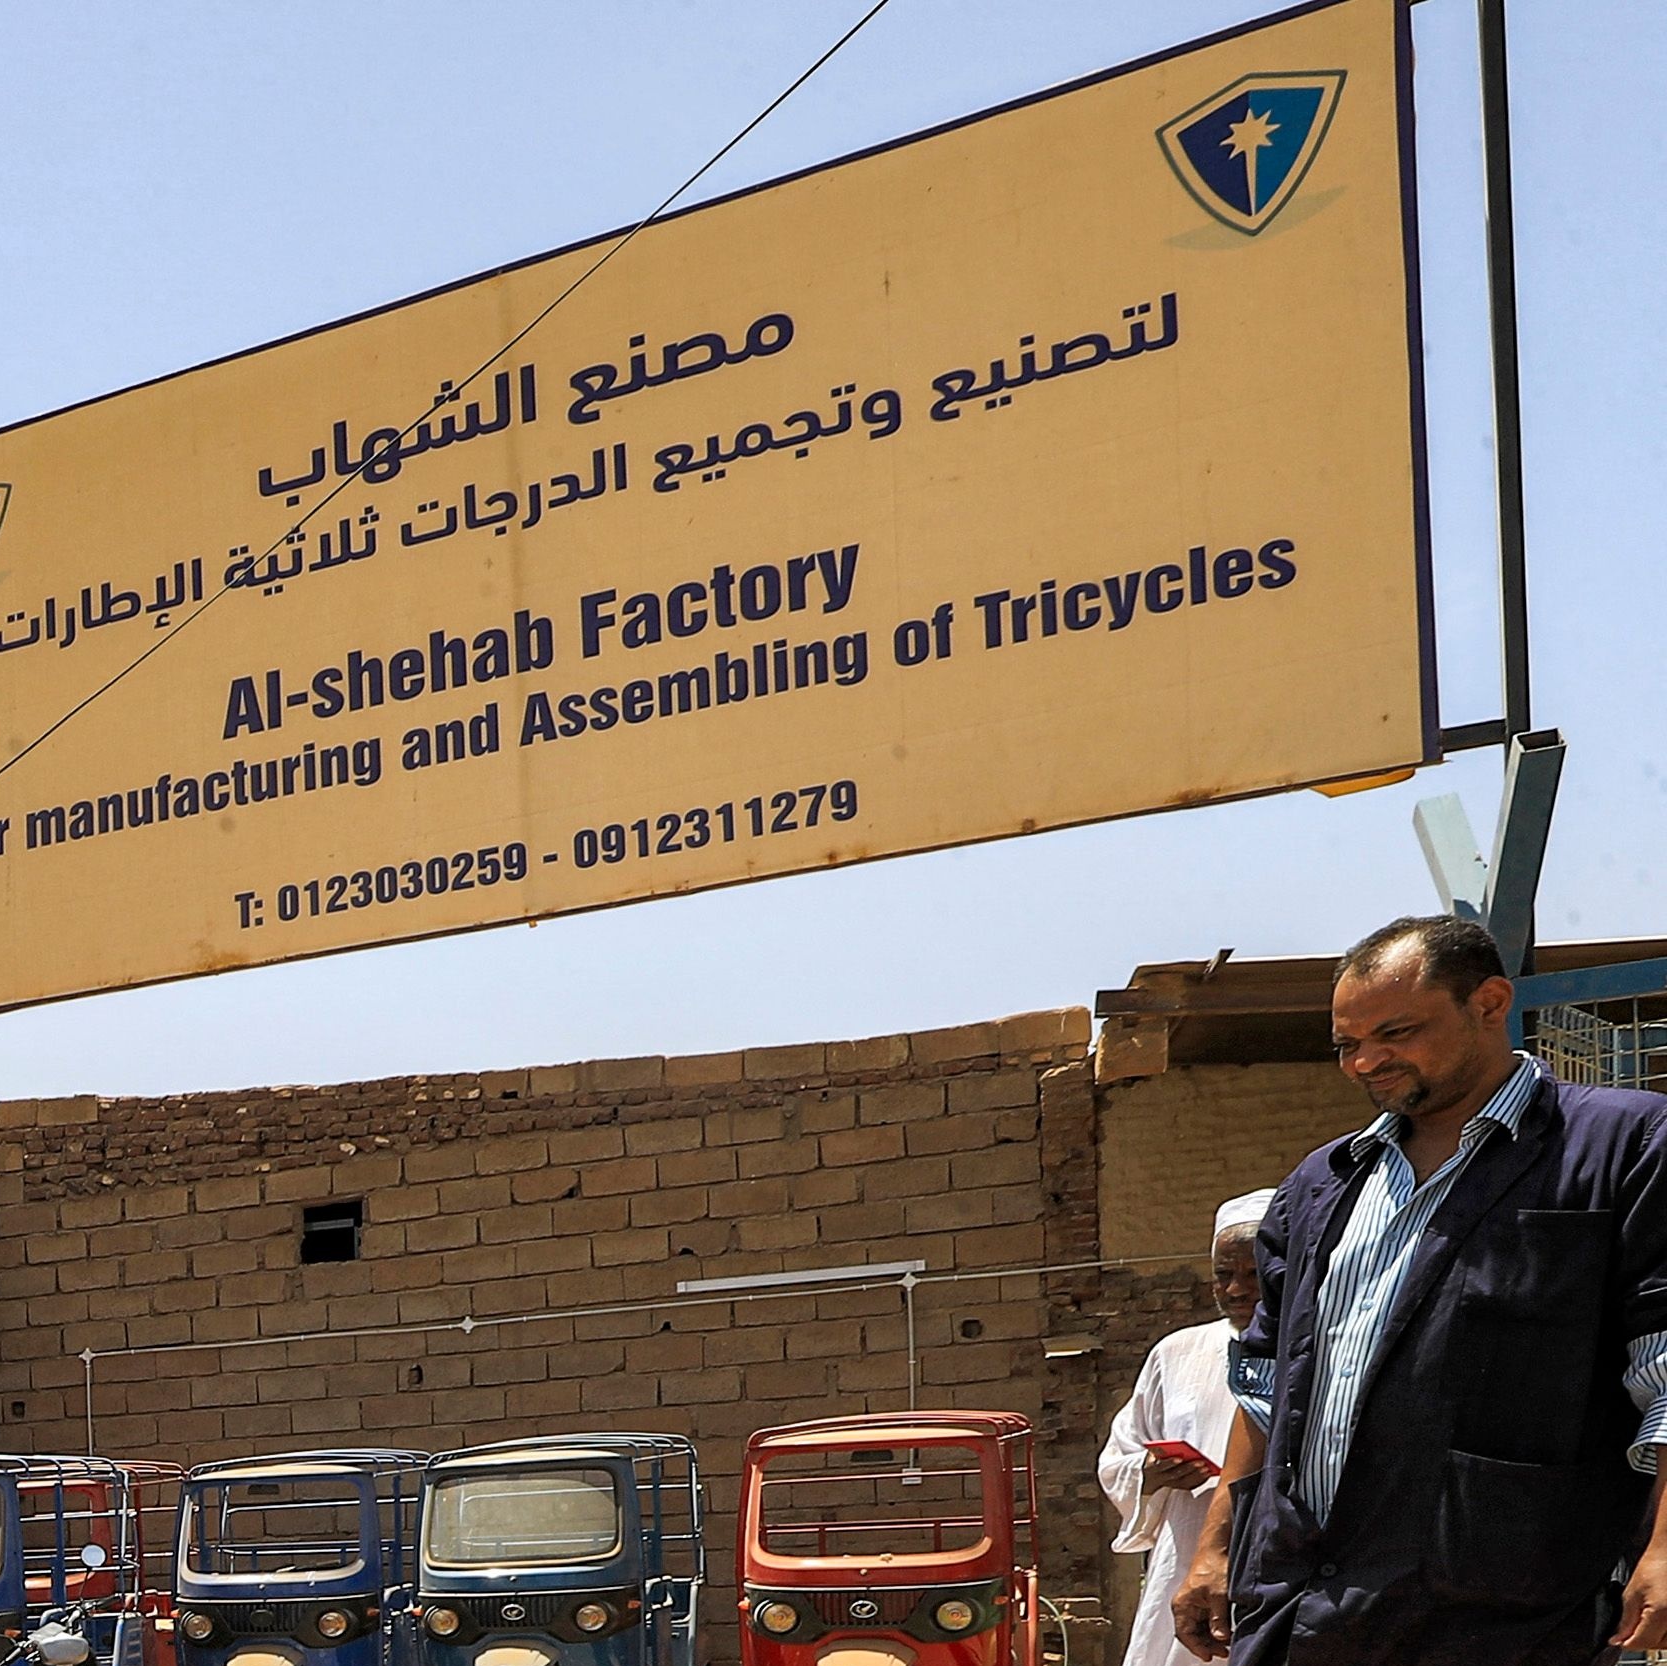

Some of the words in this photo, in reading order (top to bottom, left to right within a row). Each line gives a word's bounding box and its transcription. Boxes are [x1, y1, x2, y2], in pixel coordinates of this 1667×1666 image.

[566, 311, 796, 426] مصنع
[928, 291, 1180, 423] لتصنيع
[257, 362, 539, 509] الشهاب
[399, 441, 630, 548] الدرجات
[651, 382, 903, 494] وتجميع
[223, 504, 380, 597] ثلاثية
[25, 736, 383, 860] manufacturing
[400, 701, 501, 772] and
[518, 630, 870, 748] Assembling
[892, 601, 955, 668] of
[972, 537, 1298, 651] Tricycles
[221, 608, 555, 741] Al-shehab
[579, 542, 861, 660] Factory
[234, 890, 265, 930] T:
[276, 841, 528, 923] 0123030259
[572, 779, 859, 870] 0912311279
